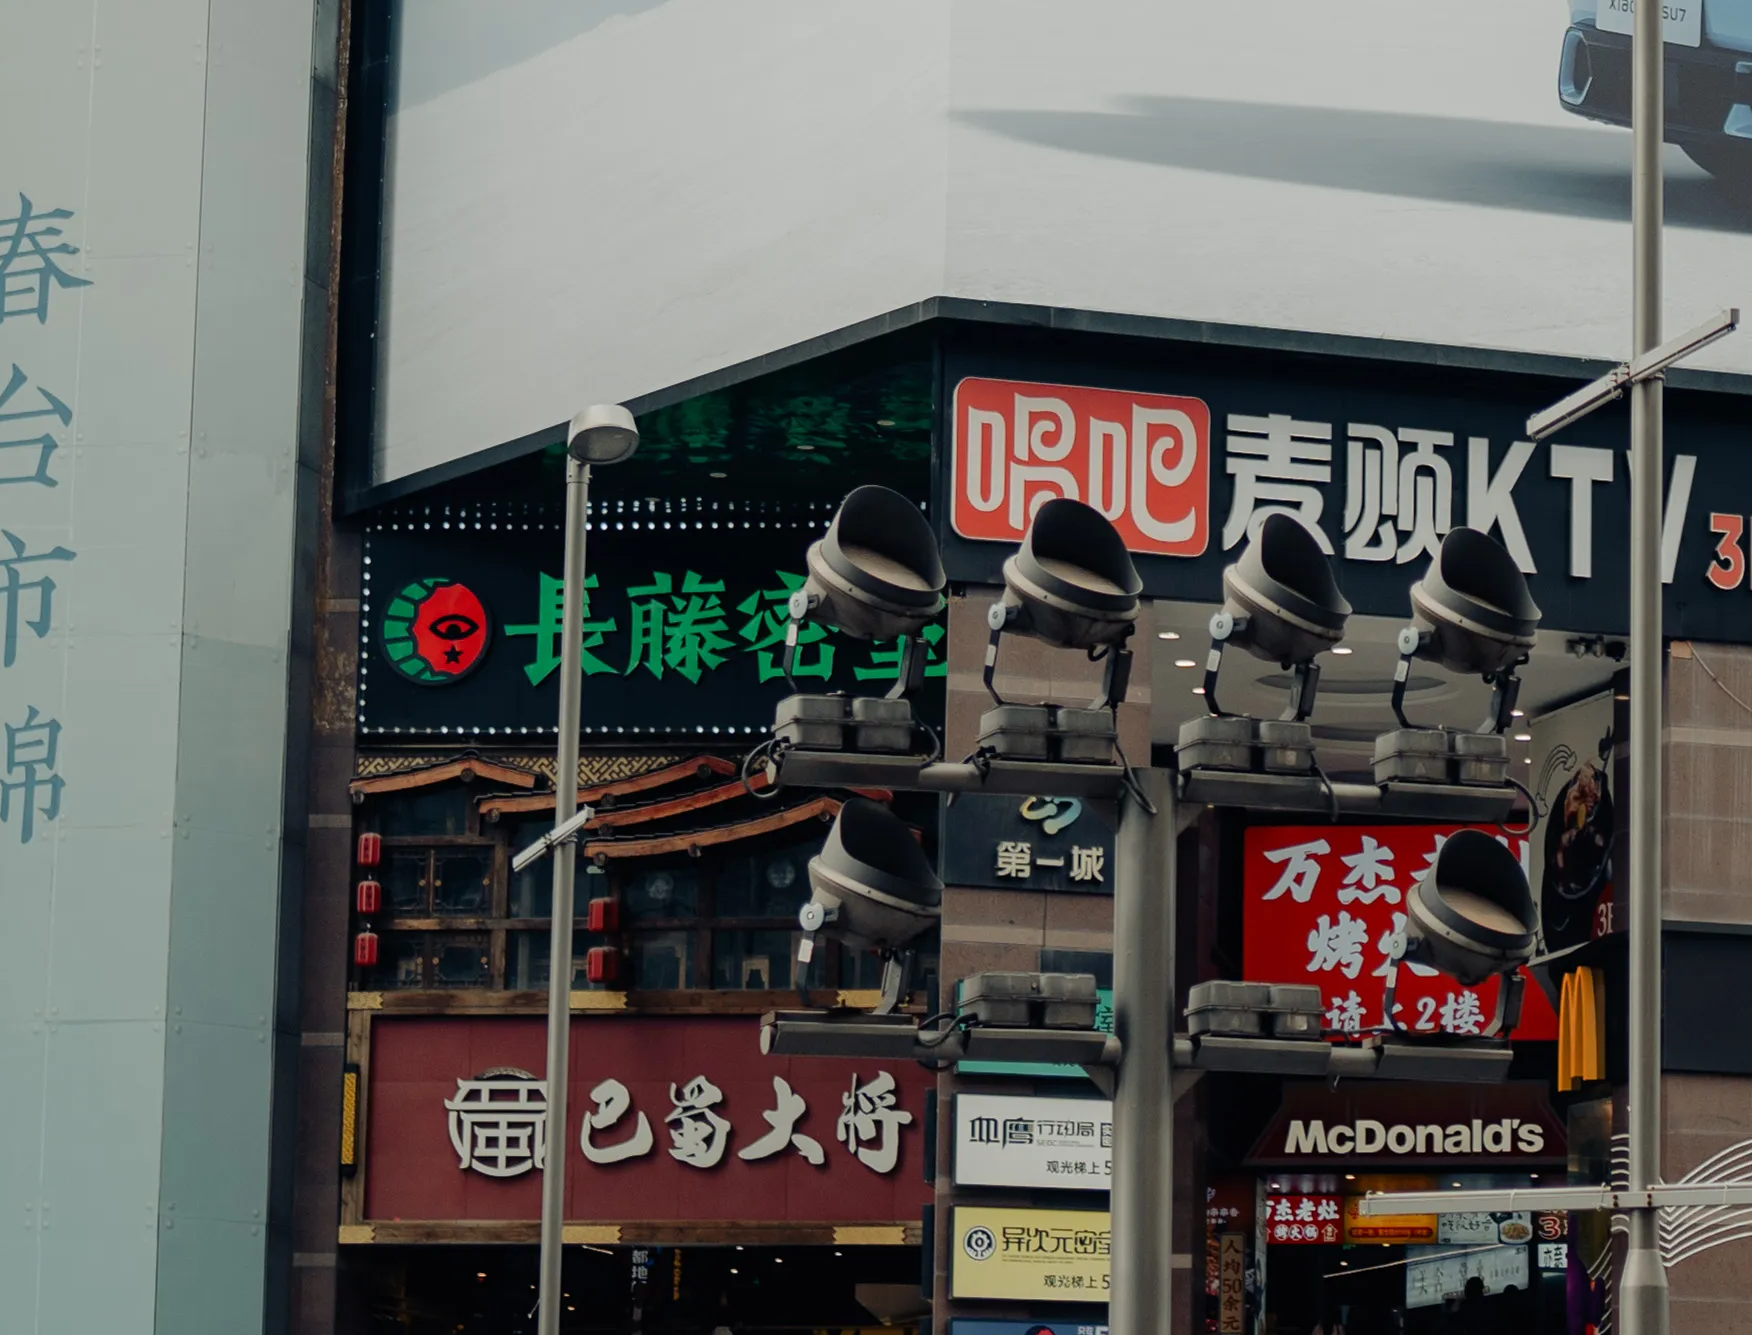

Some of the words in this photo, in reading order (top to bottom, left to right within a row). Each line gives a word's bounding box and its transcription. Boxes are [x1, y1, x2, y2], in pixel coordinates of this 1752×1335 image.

[996, 840, 1105, 883] 第一城
[579, 1069, 915, 1174] 巴蜀大将
[1284, 1118, 1545, 1155] McDonald's
[1046, 1160, 1100, 1175] 观光梯上
[1044, 1274, 1098, 1289] 观光梯上
[1222, 1239, 1242, 1332] 人均50余元
